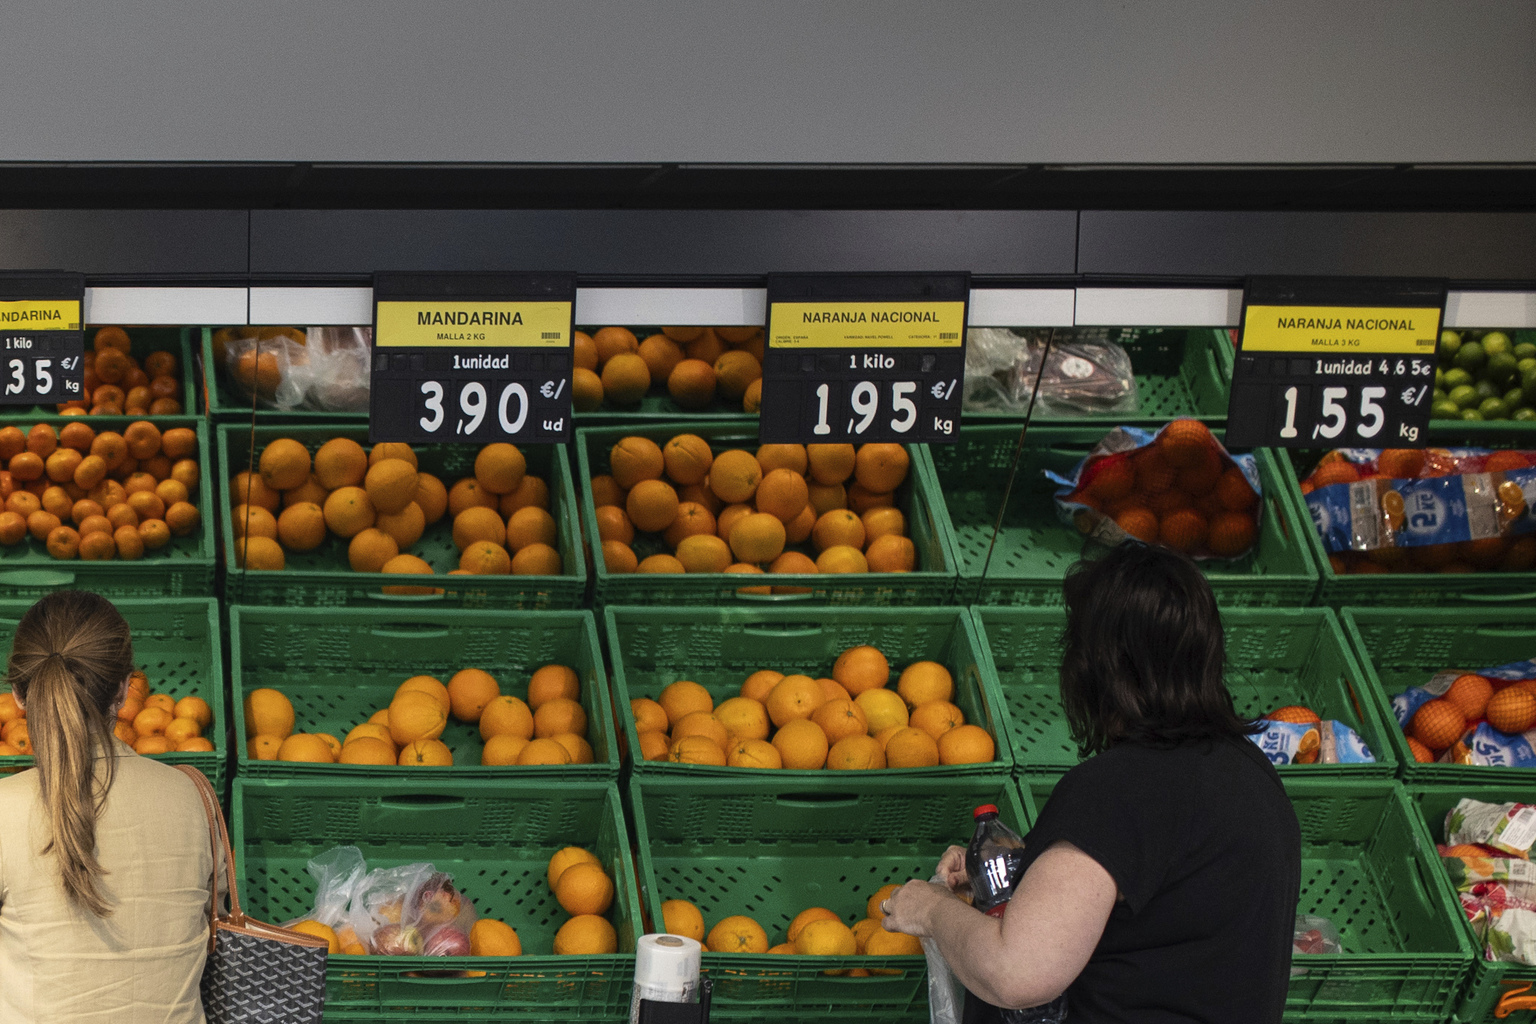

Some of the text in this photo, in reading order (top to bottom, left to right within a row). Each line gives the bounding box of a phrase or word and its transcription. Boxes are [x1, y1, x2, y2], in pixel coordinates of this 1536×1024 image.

[417, 311, 523, 326] MANDARINA
[803, 311, 940, 323] NARANJA NACIONAL
[1277, 317, 1416, 331] NARANJA NACIONAL
[5, 337, 33, 349] 1 kilo
[436, 333, 485, 341] MALLA 2 KG
[1311, 338, 1339, 346] MALLA
[1348, 339, 1360, 347] KG
[849, 354, 895, 369] 1 kilo
[65, 379, 80, 392] kg
[542, 418, 563, 432] ud
[934, 416, 953, 434] kg
[1399, 422, 1419, 442] kg
